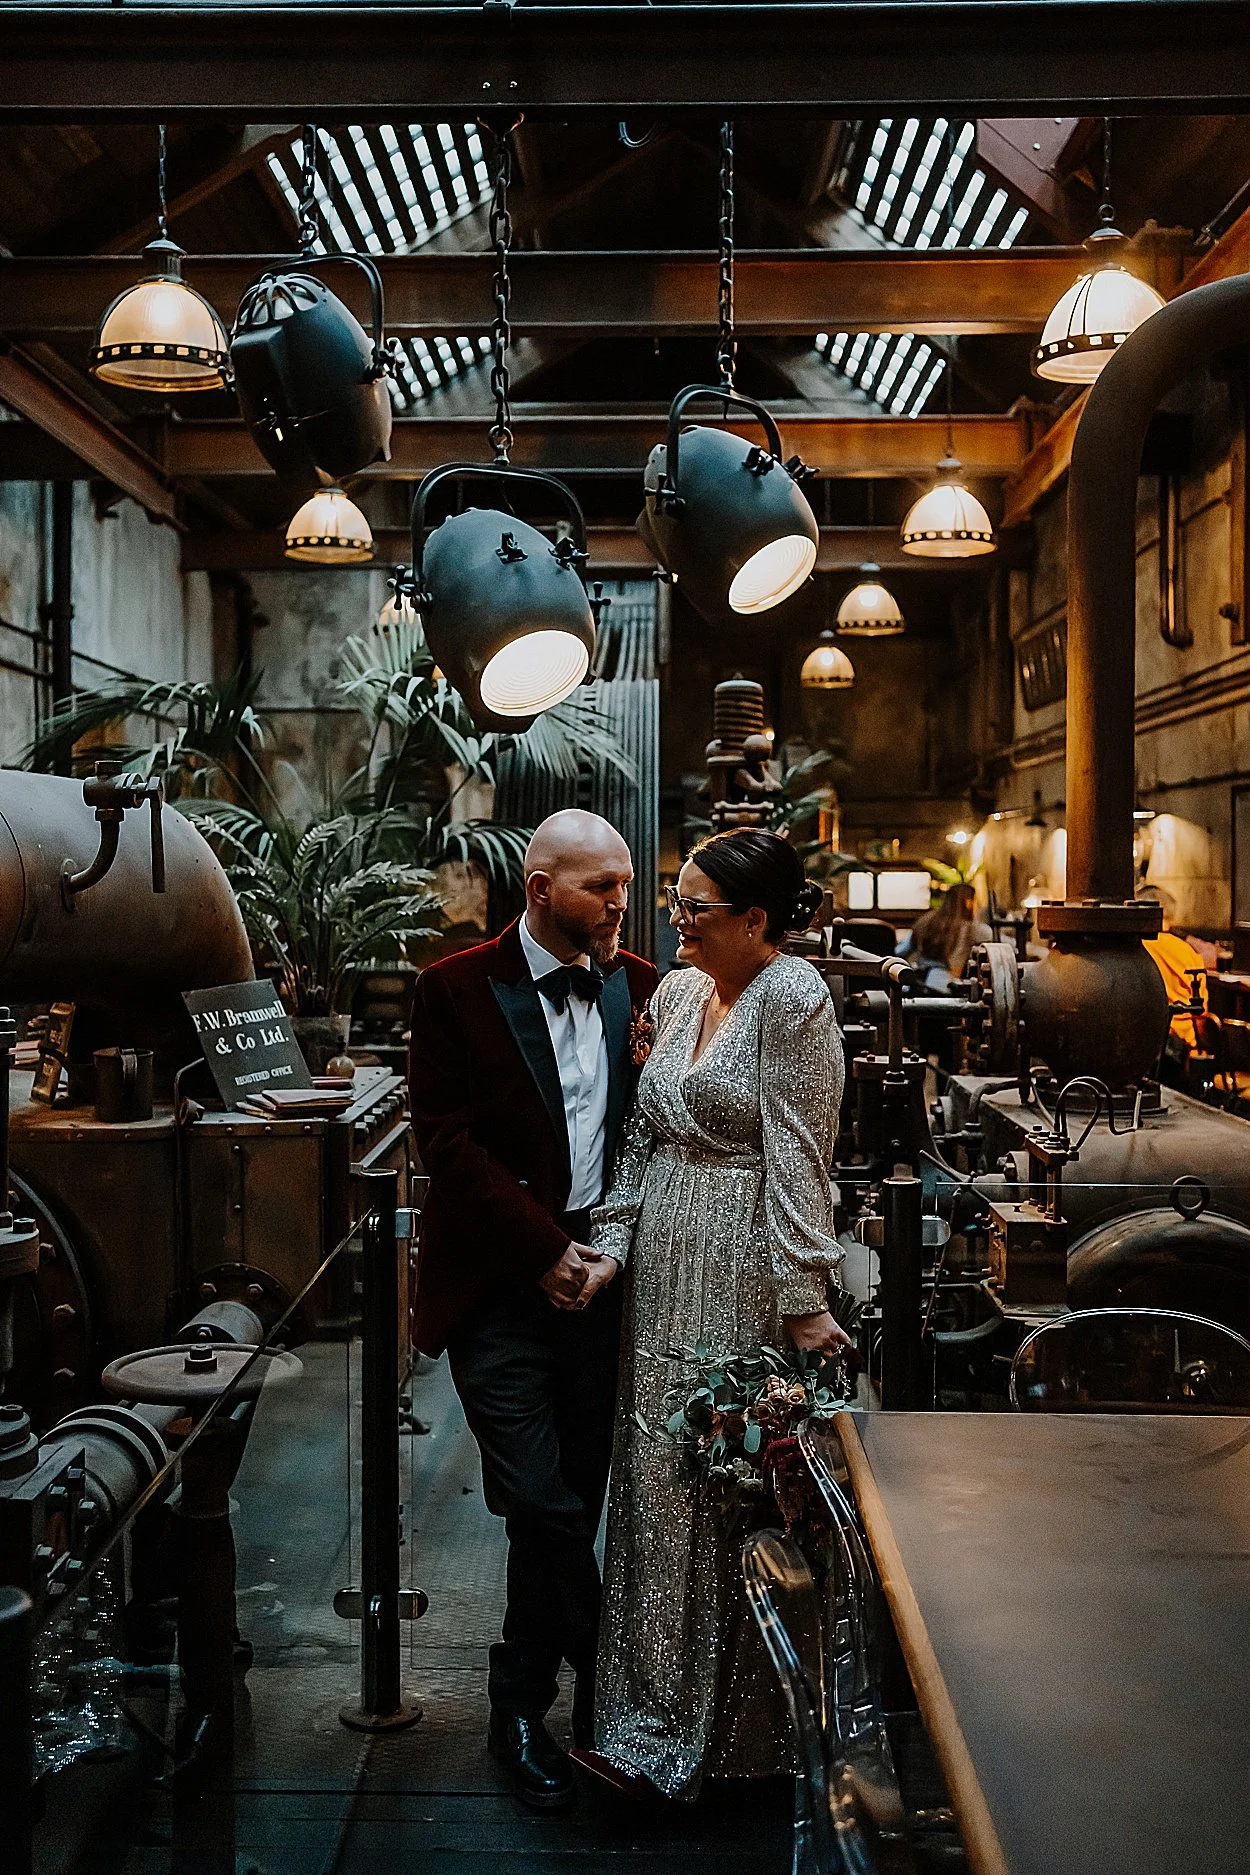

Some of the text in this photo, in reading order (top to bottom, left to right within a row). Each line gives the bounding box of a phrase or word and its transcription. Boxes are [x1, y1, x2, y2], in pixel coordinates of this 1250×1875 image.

[215, 1025, 290, 1055] & Co Ltd.
